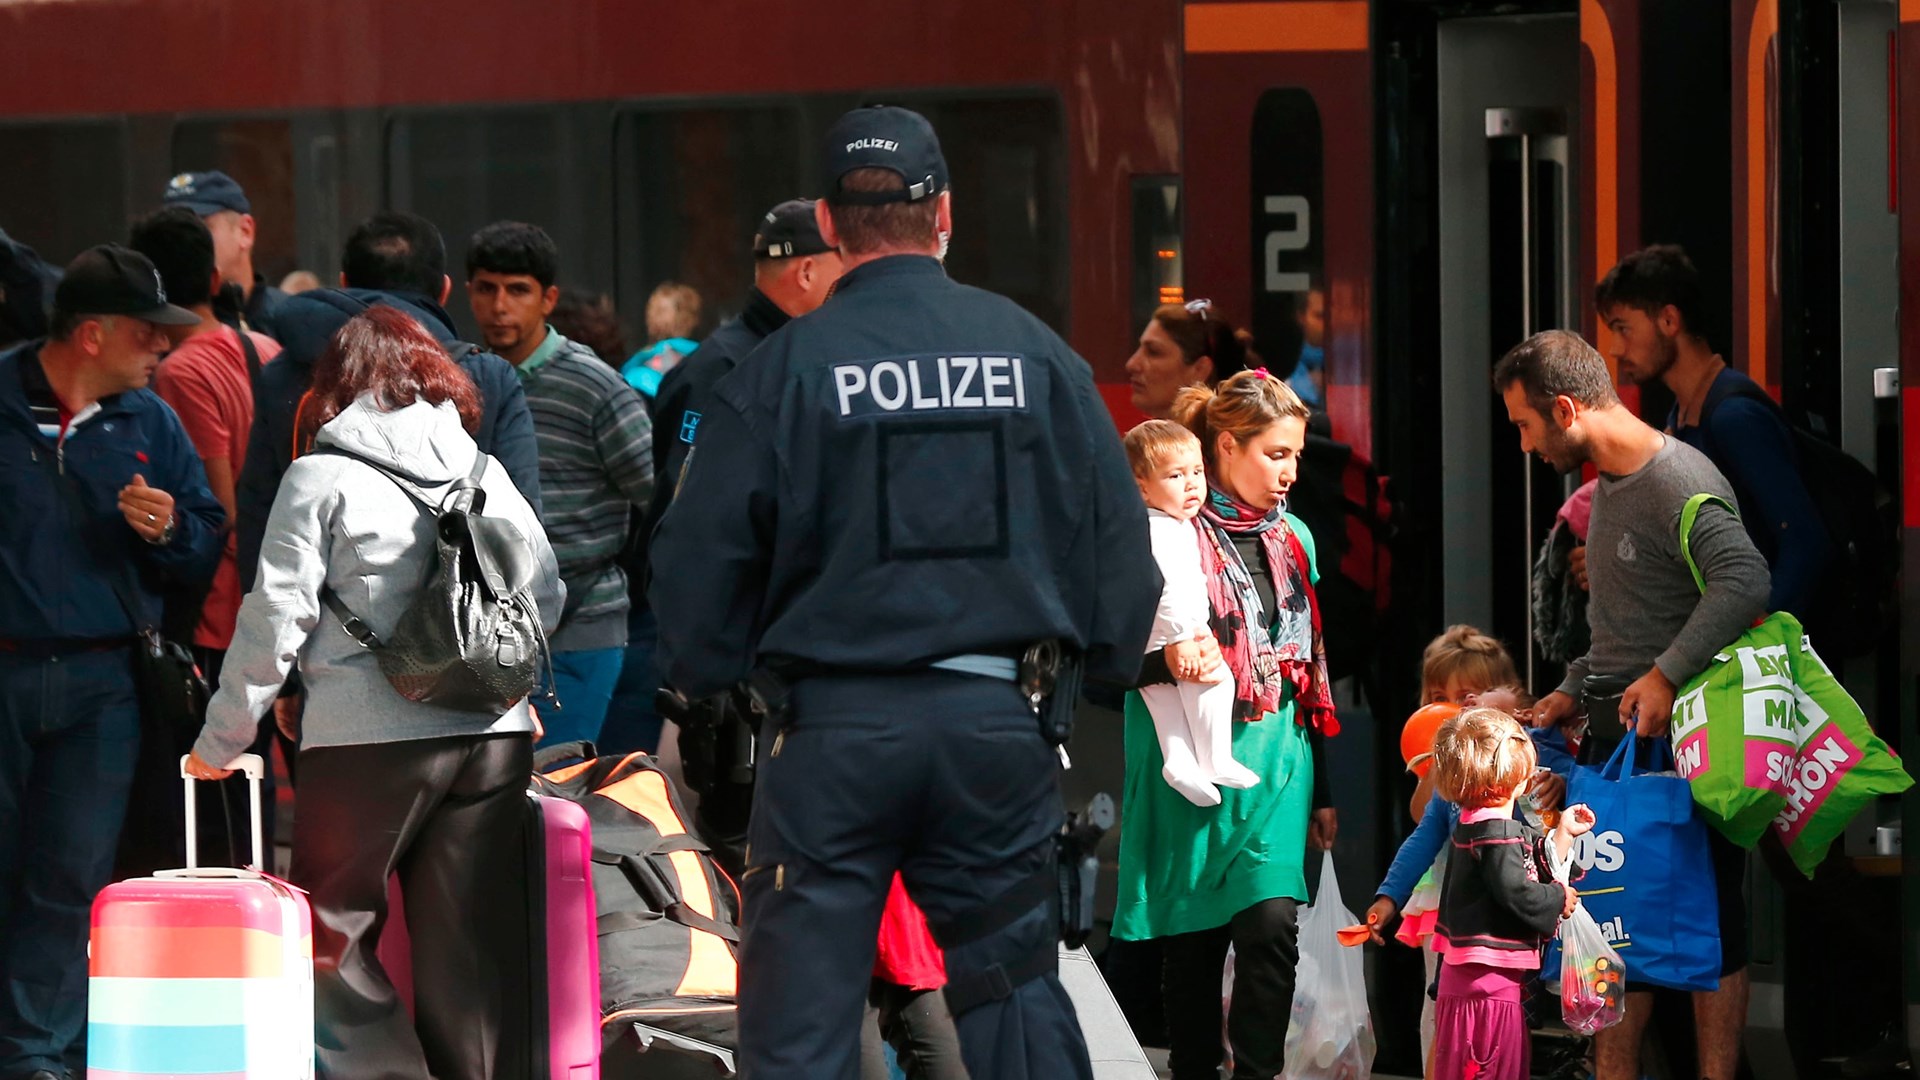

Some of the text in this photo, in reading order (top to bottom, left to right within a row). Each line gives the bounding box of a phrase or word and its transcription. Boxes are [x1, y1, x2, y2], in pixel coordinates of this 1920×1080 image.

[846, 137, 899, 153] POLIZEI
[1264, 195, 1310, 292] 2
[834, 357, 1026, 416] POLIZEI
[1572, 829, 1626, 873] OS
